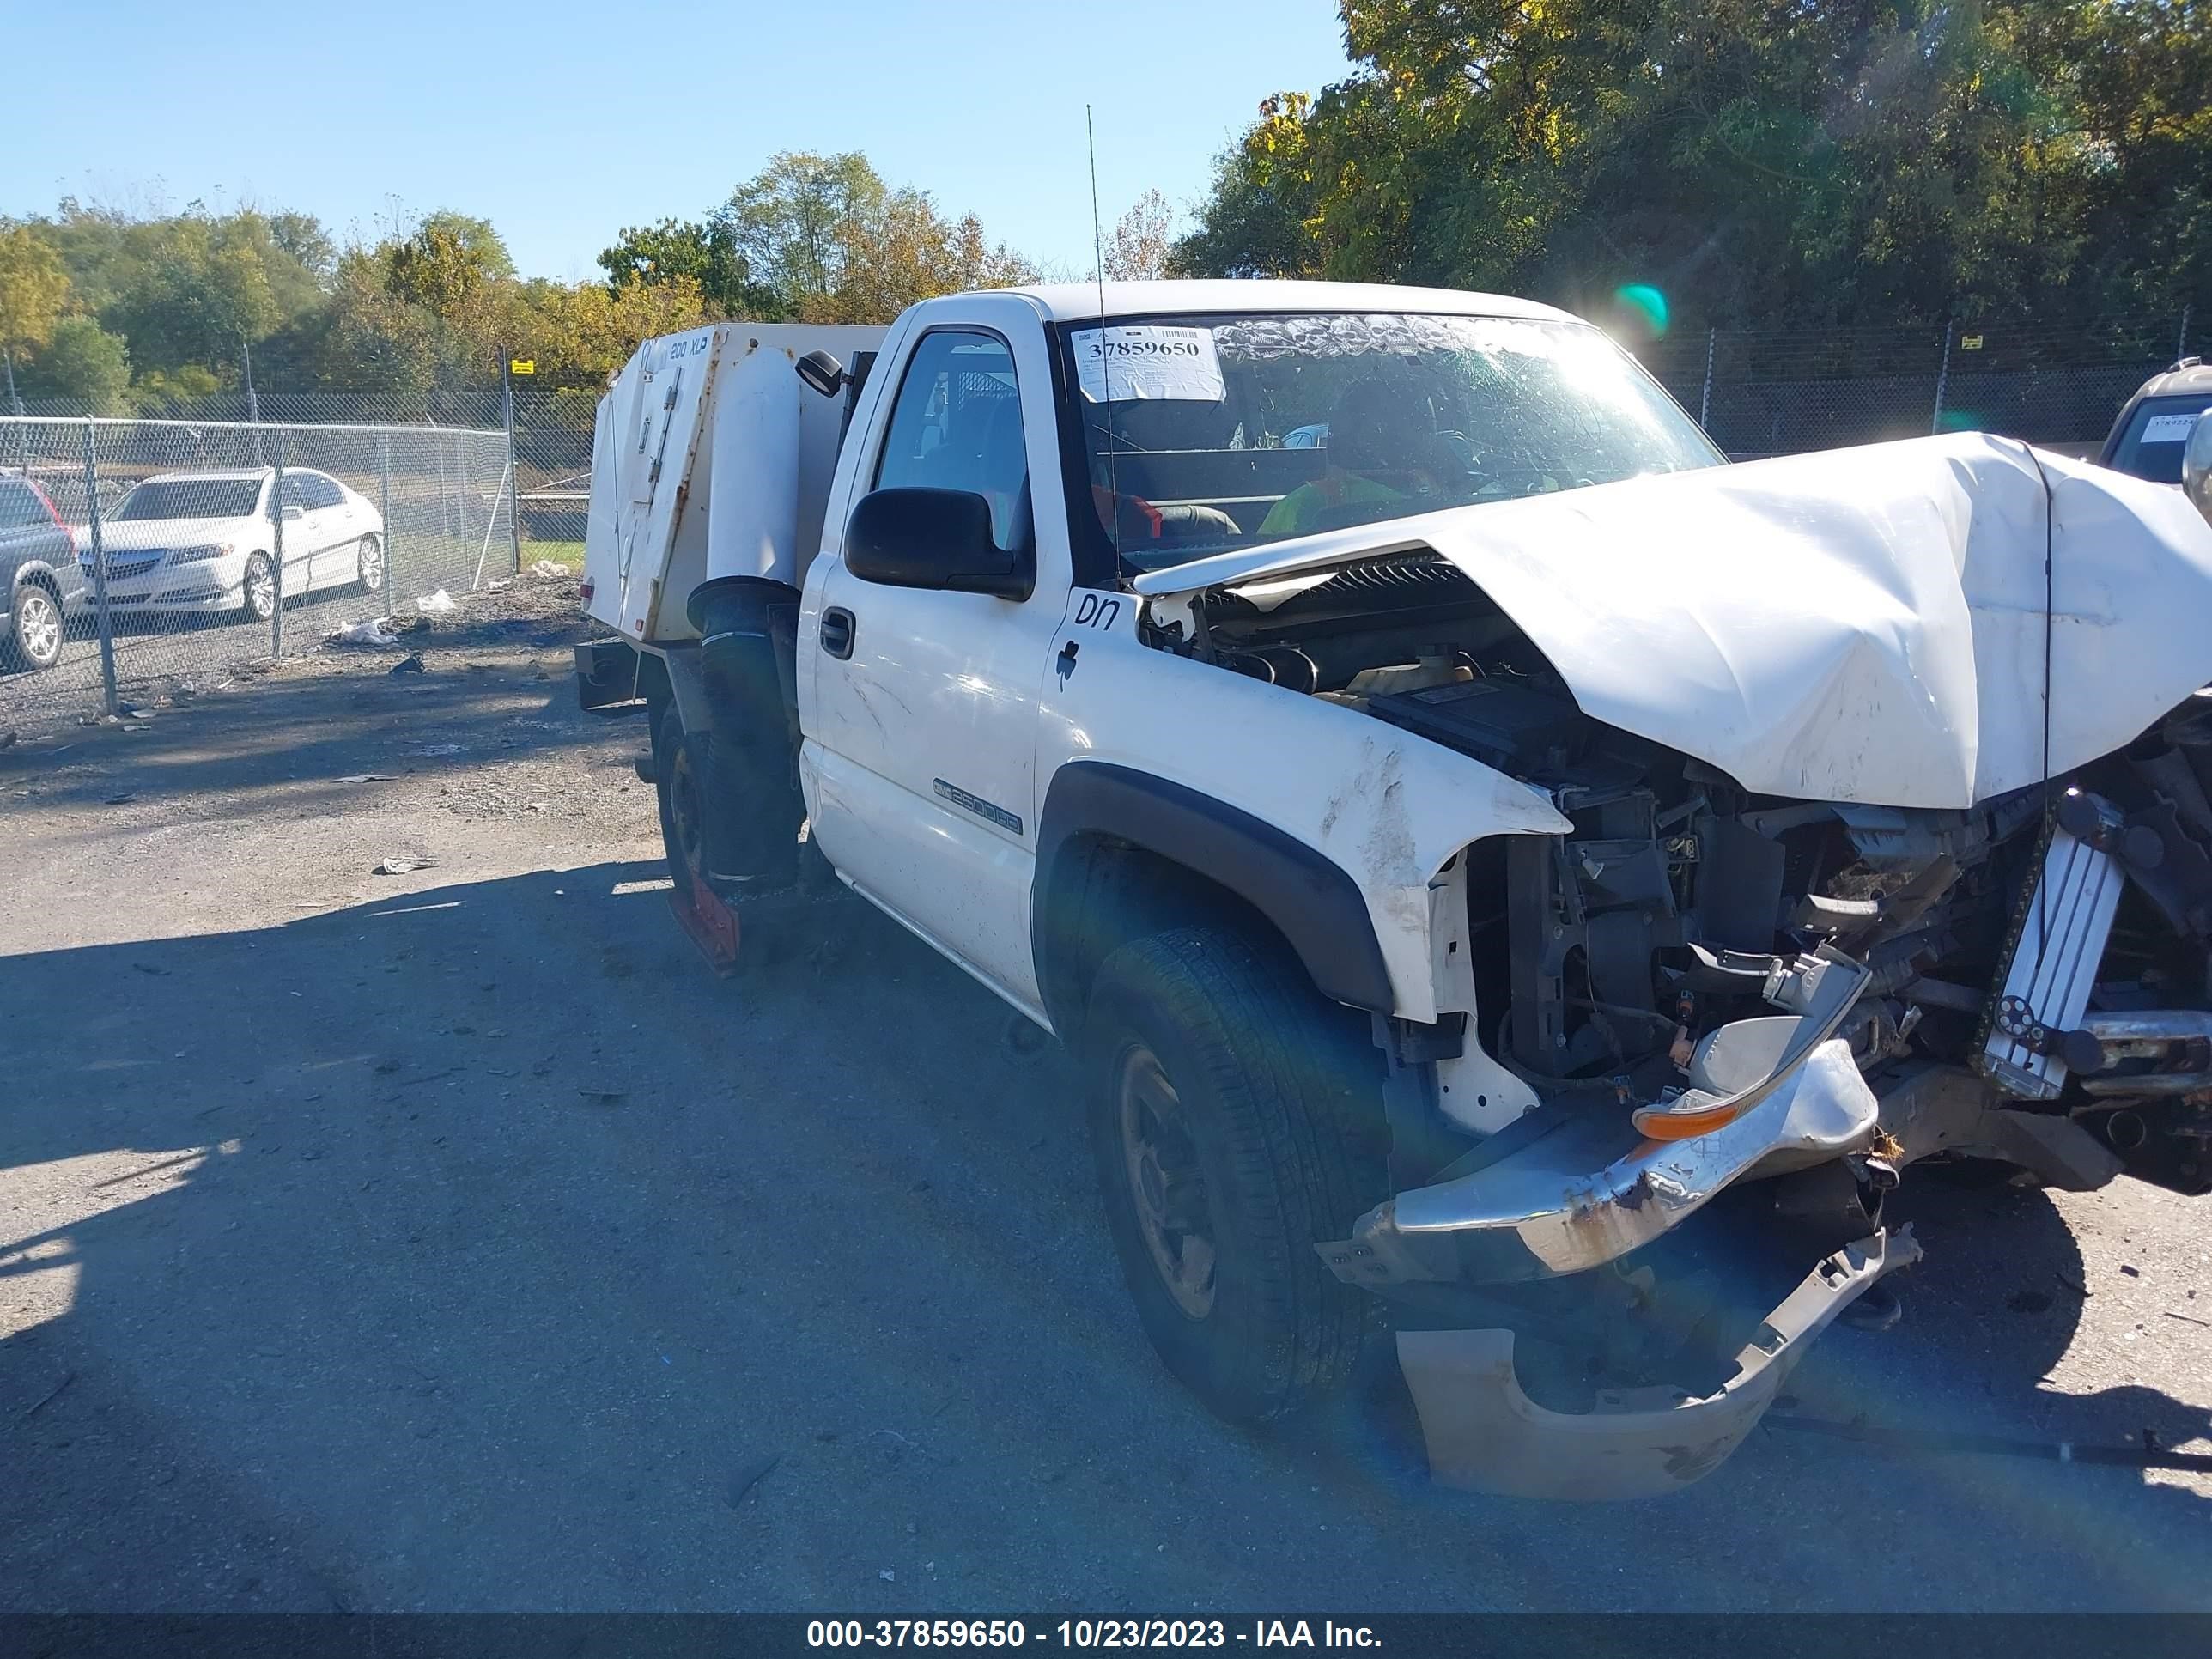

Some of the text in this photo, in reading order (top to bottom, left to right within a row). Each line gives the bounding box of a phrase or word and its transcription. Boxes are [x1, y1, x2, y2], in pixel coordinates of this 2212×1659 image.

[670, 337, 708, 360] 200 XLP
[1089, 342, 1200, 358] 37859650
[952, 788, 996, 822] 2500
